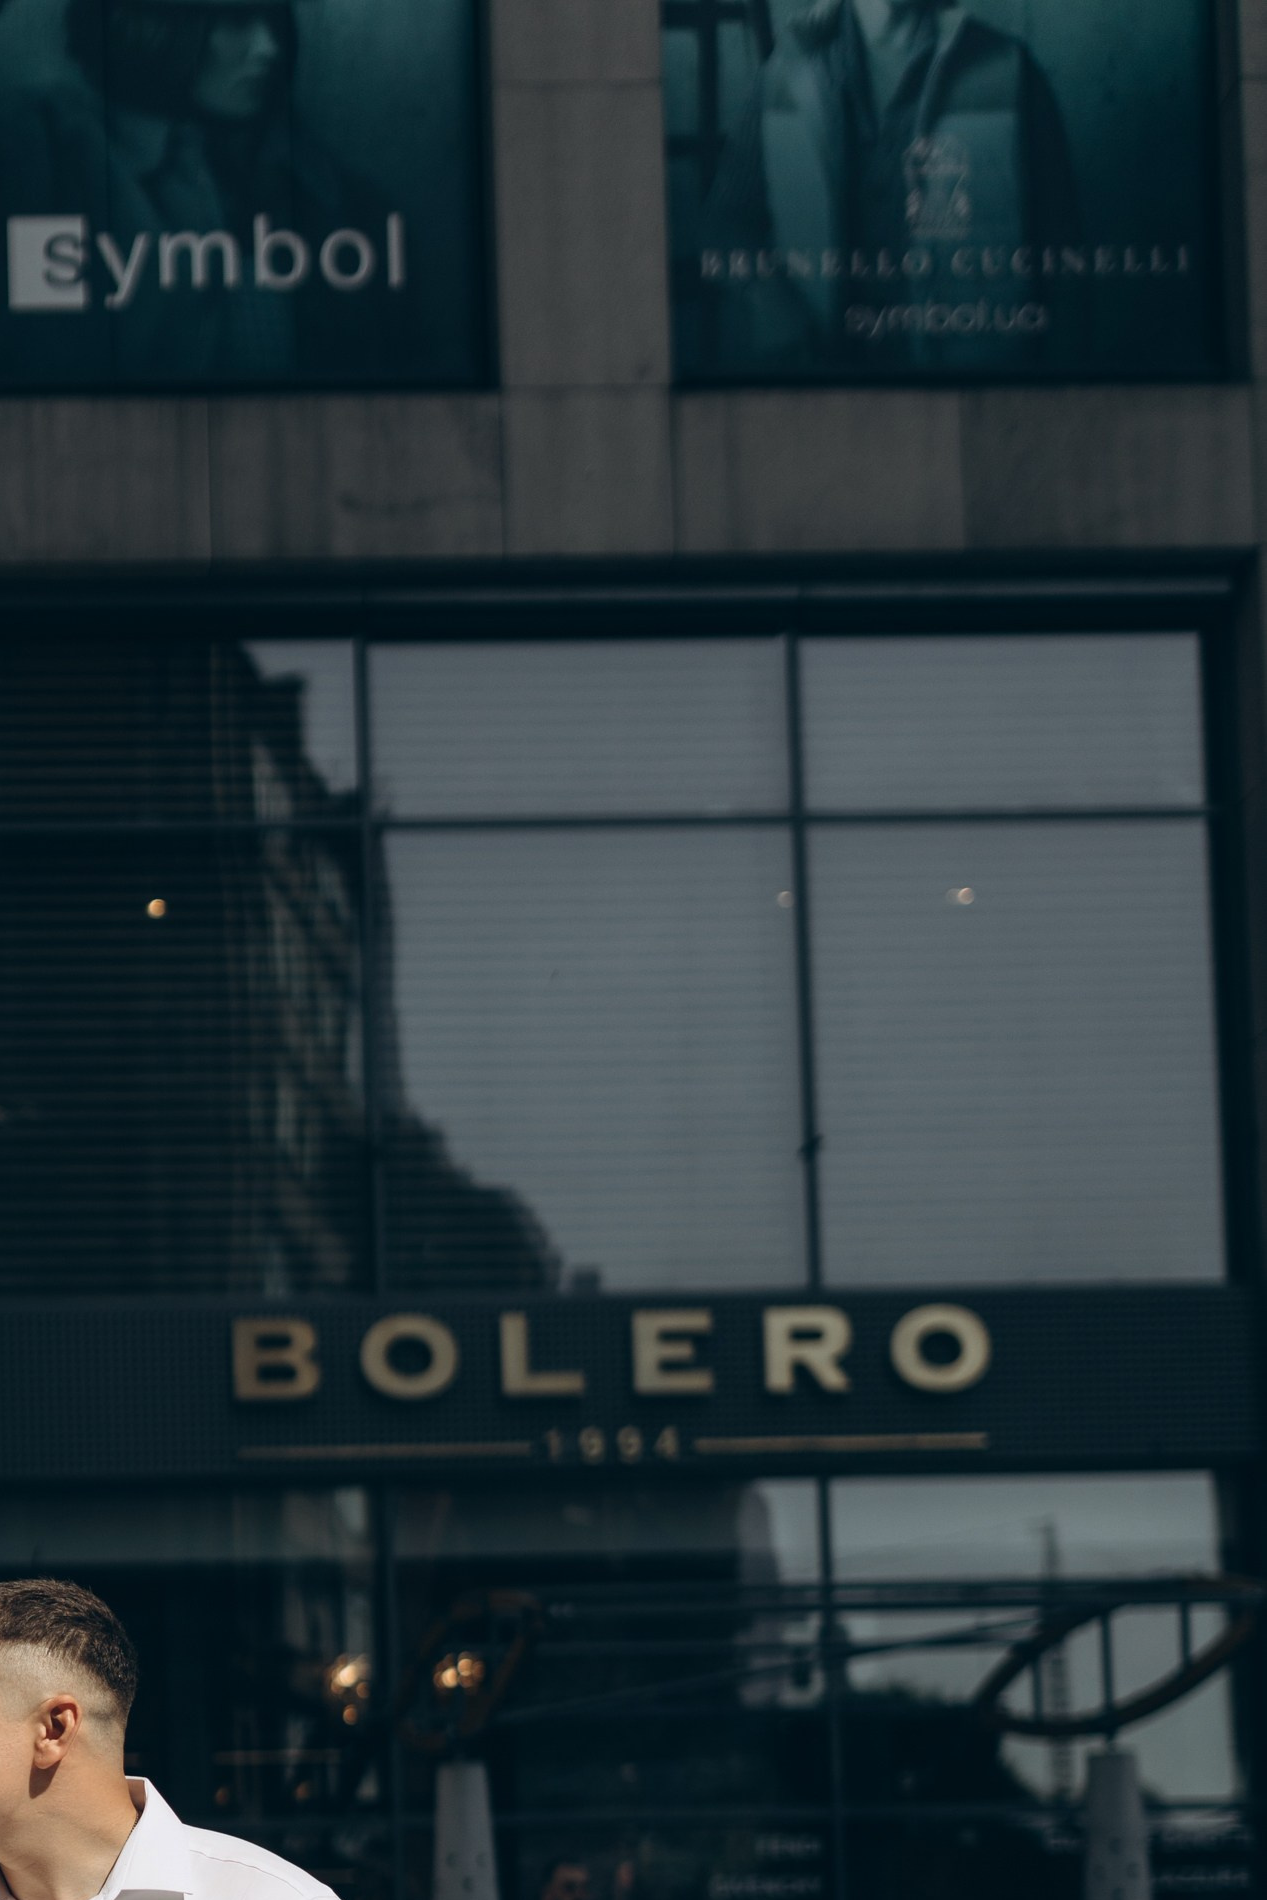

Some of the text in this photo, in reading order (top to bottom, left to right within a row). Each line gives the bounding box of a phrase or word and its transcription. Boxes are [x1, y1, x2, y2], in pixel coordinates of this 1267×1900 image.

[700, 243, 1192, 281] BRUNELLO CUCINELLI
[230, 1301, 993, 1401] BOLERO
[542, 1424, 681, 1466] 1994
